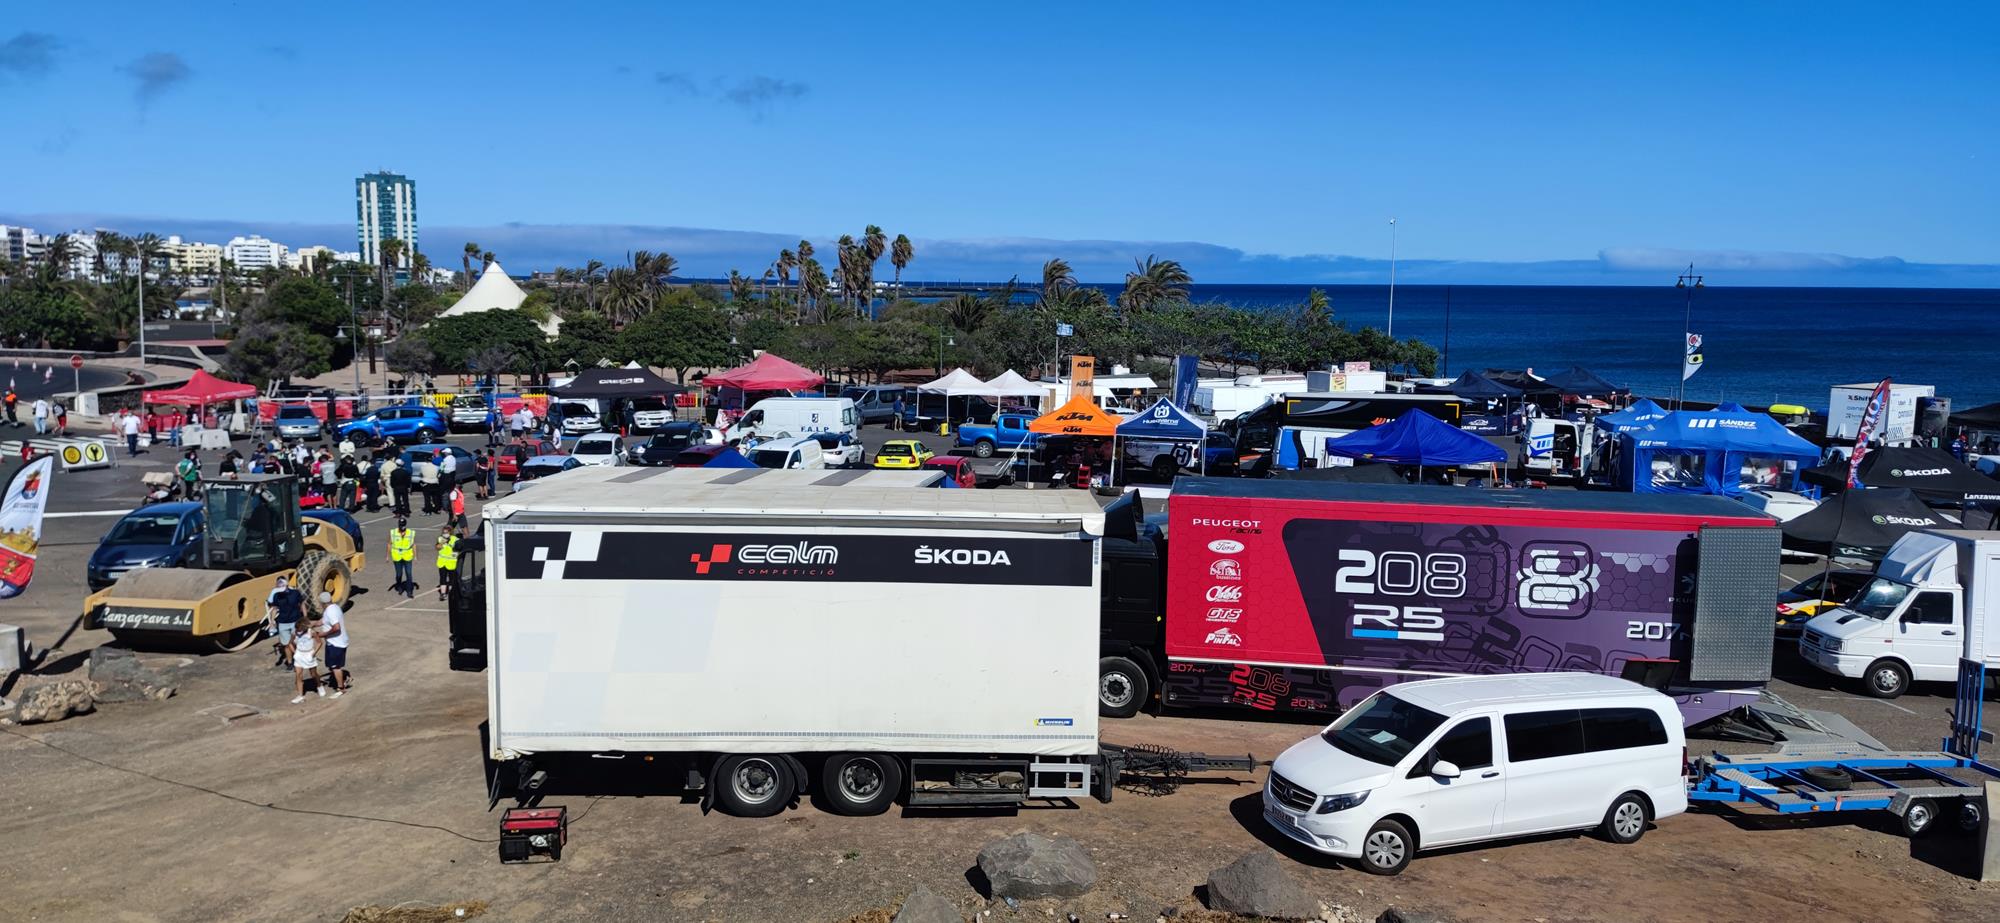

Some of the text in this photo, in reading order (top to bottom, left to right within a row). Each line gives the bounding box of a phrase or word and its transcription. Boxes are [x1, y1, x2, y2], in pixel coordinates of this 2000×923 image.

[1056, 412, 1093, 421] KTM
[1904, 468, 1951, 476] ŠKODA
[1192, 519, 1261, 528] PEUGEOT
[1886, 515, 1936, 526] ŠKODA
[738, 541, 838, 564] calm
[1215, 542, 1236, 551] Ford
[914, 545, 1011, 566] ŠKODA
[737, 568, 835, 576] COMPETICIÓ
[1335, 549, 1467, 598] 208
[97, 606, 170, 629] Lanzagrava
[1207, 607, 1243, 620] GTS
[1353, 603, 1445, 629] R5
[1228, 663, 1291, 697] 208
